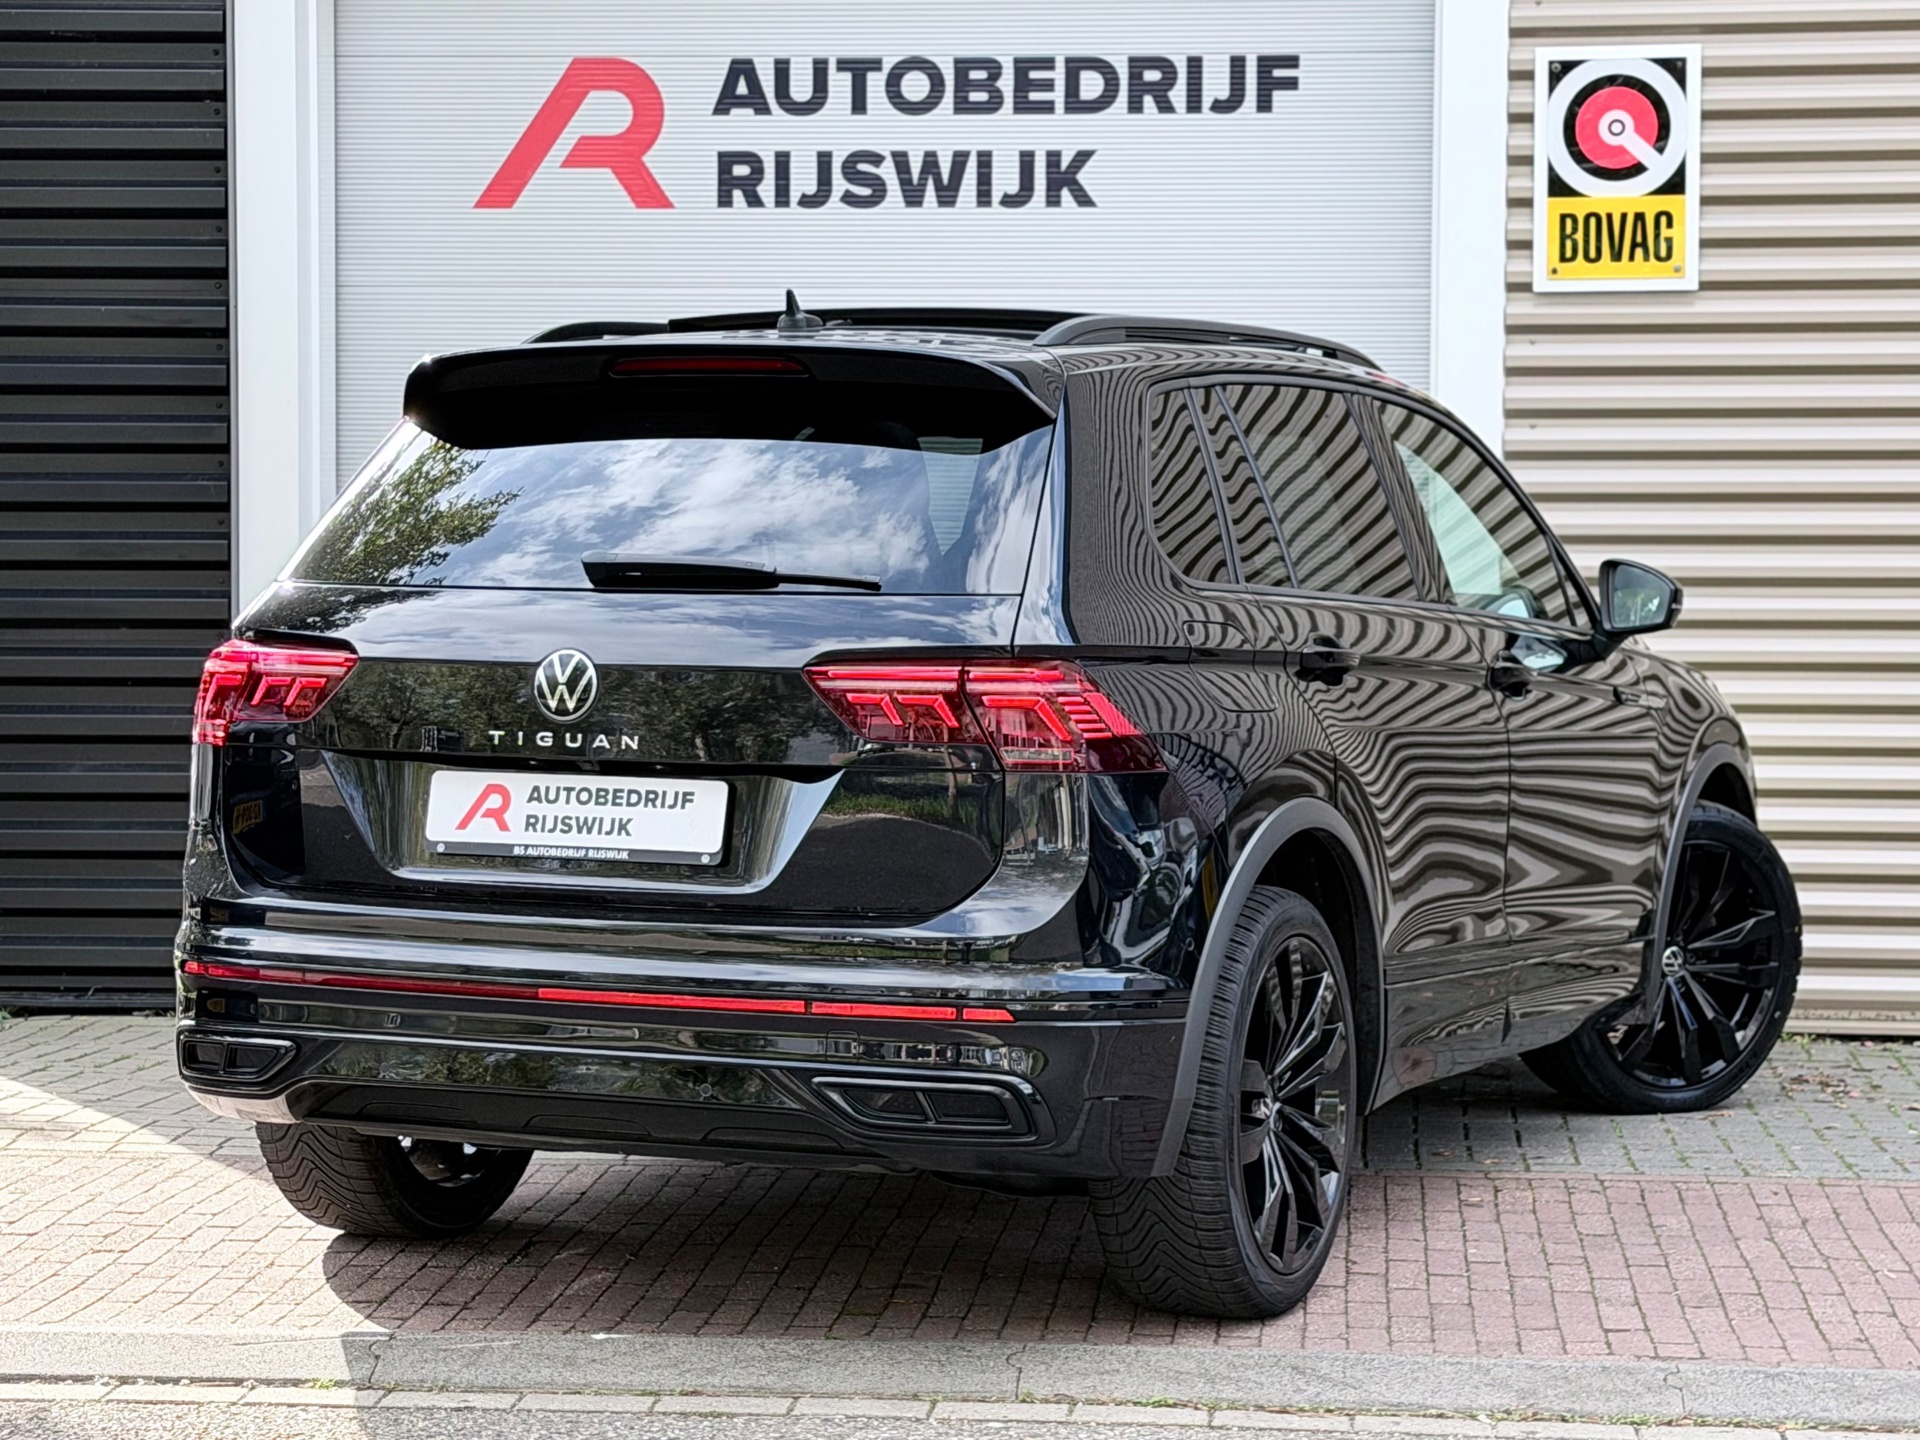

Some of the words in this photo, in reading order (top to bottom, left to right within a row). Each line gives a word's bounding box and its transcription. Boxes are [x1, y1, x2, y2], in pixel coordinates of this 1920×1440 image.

[713, 55, 1299, 114] AUTOBEDRIJF
[717, 150, 1097, 208] RIJSWIJK
[1559, 210, 1673, 263] BOVAG
[489, 731, 640, 750] TIGUAN
[526, 785, 695, 810] AUTOBEDRIJF
[523, 815, 633, 837] RIJSWIJK
[513, 846, 525, 855] BS
[527, 846, 586, 858] AUTOBEDRIJF
[588, 850, 629, 860] RIJSWIJK
